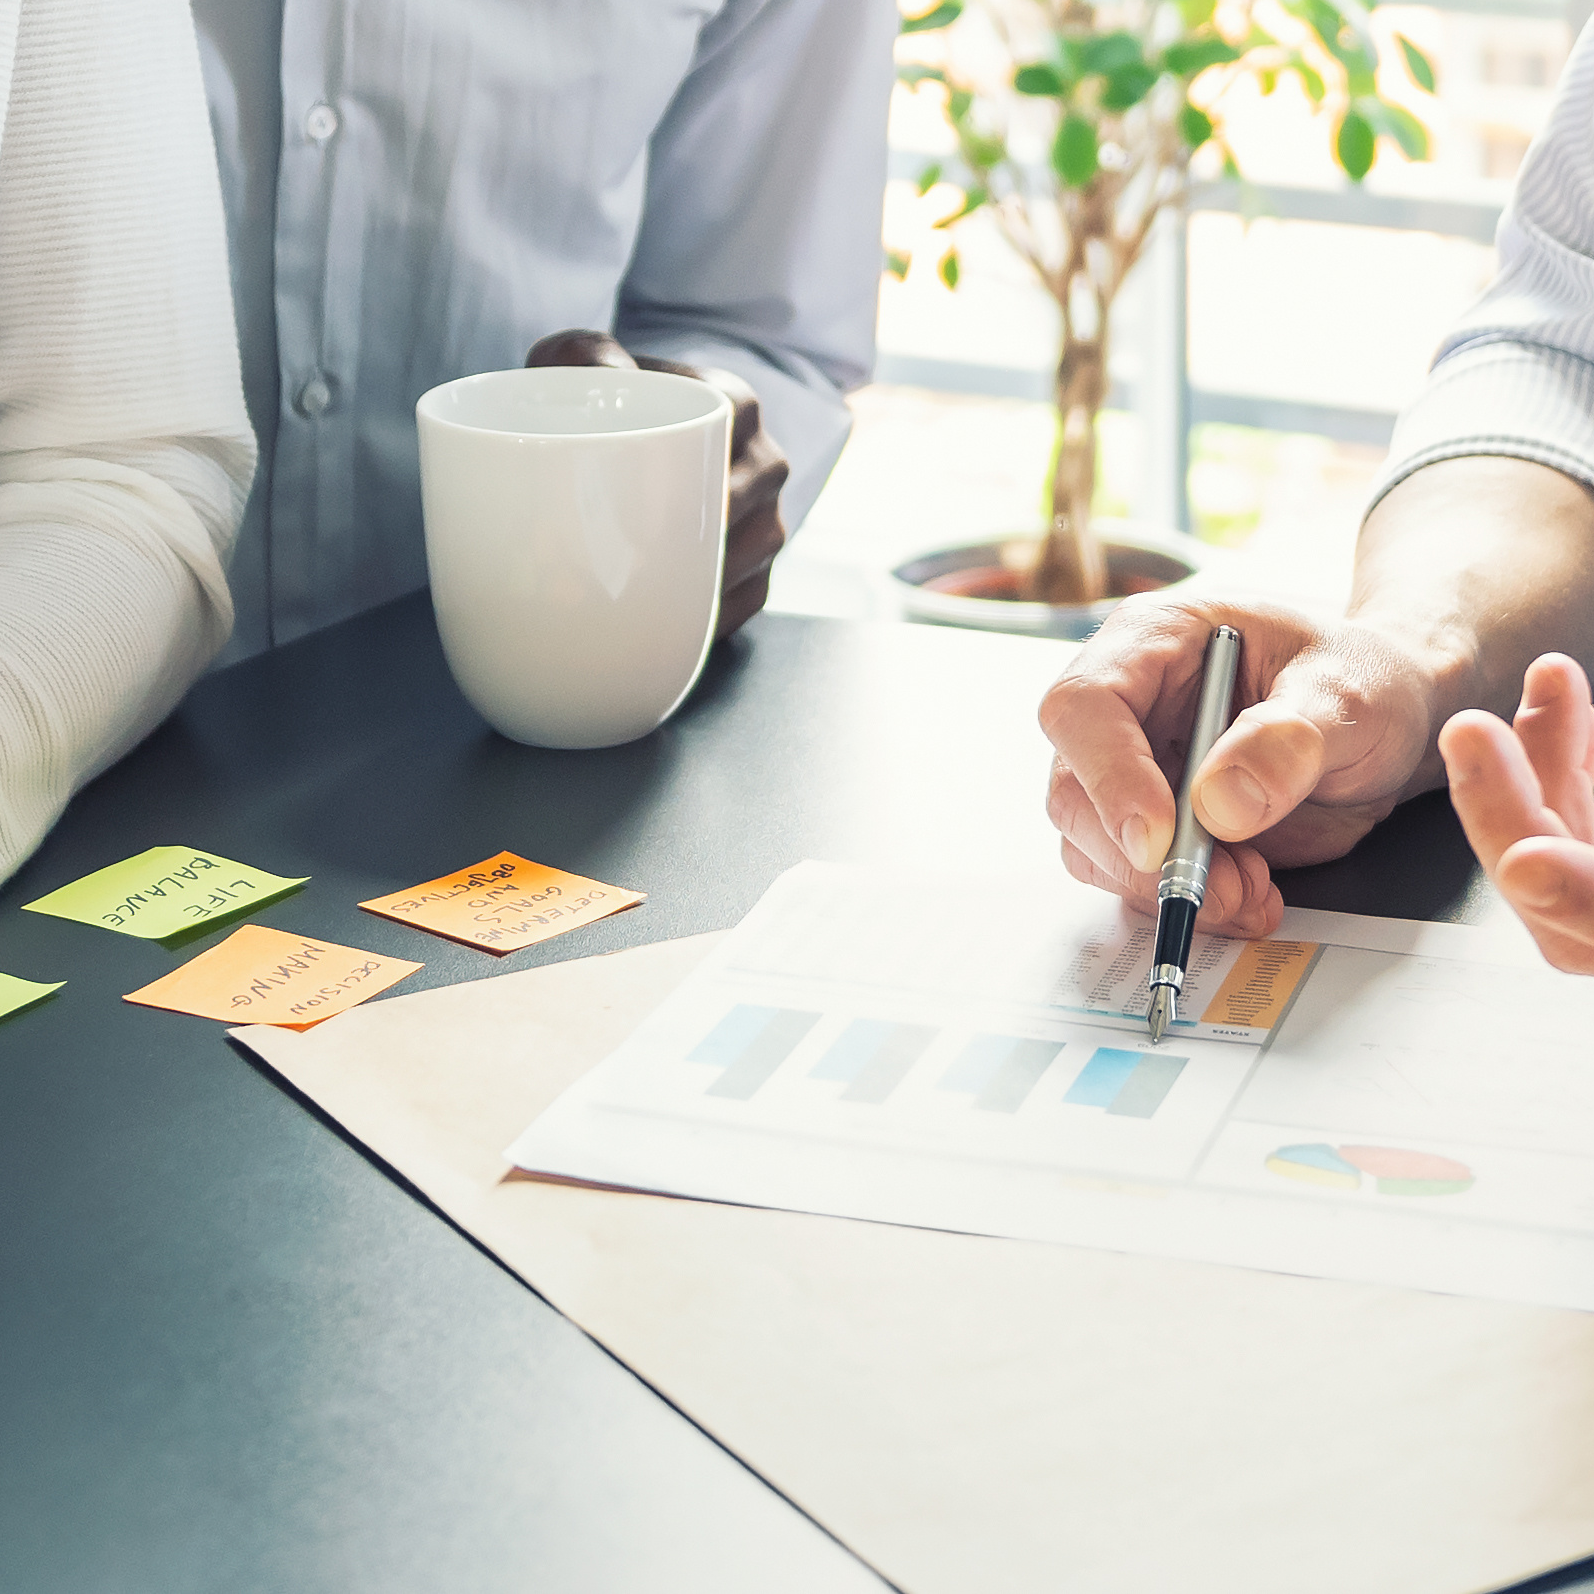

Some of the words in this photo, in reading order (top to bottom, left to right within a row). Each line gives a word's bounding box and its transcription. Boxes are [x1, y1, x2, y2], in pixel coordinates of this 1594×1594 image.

[102, 857, 221, 926] BALANCE
[183, 880, 256, 918] LIFE
[467, 883, 520, 909] AND
[473, 886, 563, 925] GOALS
[231, 943, 326, 1008] MAKING
[290, 960, 382, 1015] DECISION
